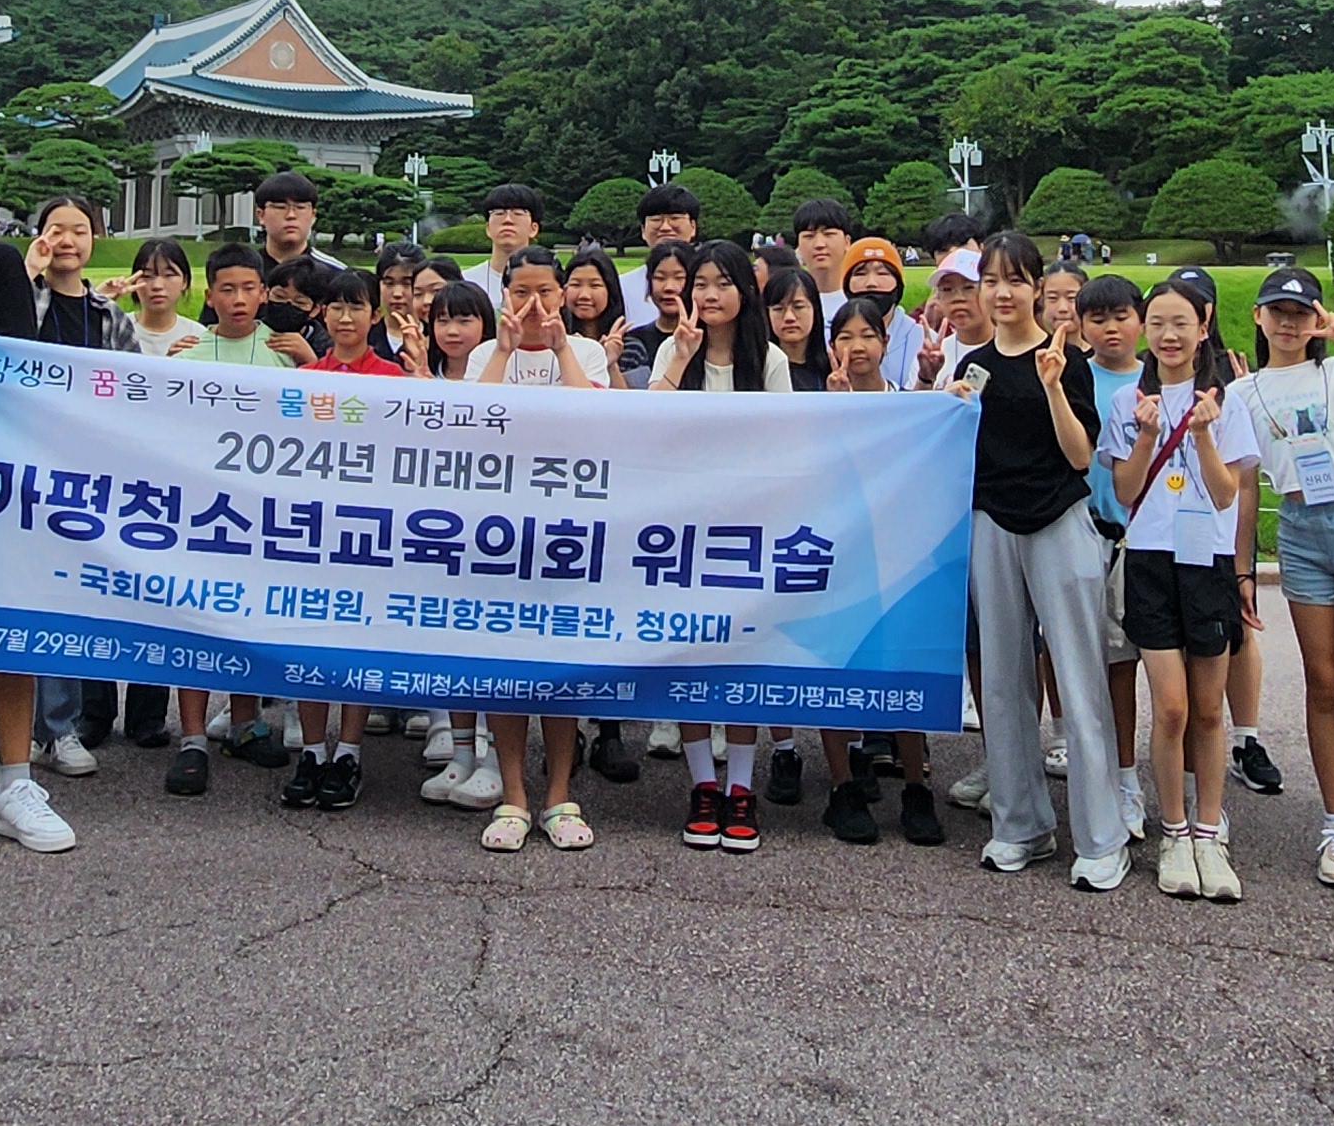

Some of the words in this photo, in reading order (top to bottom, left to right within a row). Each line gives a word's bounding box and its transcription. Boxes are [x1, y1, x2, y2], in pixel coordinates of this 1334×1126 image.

[89, 369, 153, 401] 꿈을
[167, 379, 261, 412] 키우는
[276, 387, 369, 424] 물별숲
[384, 399, 513, 436] 가평교육
[214, 431, 376, 485] 2024년
[392, 444, 515, 494] 미래의
[529, 456, 610, 500] 주인
[632, 524, 836, 593] 워크숍
[79, 562, 252, 618] 국회의사당,
[264, 583, 373, 626] 대법원,
[385, 592, 622, 643] 국립항공박물관,
[636, 609, 731, 644] 청와대
[171, 647, 251, 677] 31일(수)
[284, 663, 325, 686] 장소
[342, 667, 384, 693] 서울
[389, 671, 637, 702] 국제청소년센터유스호스텔
[668, 681, 709, 704] 주관
[724, 682, 925, 712] 경기도가평교육지원청
